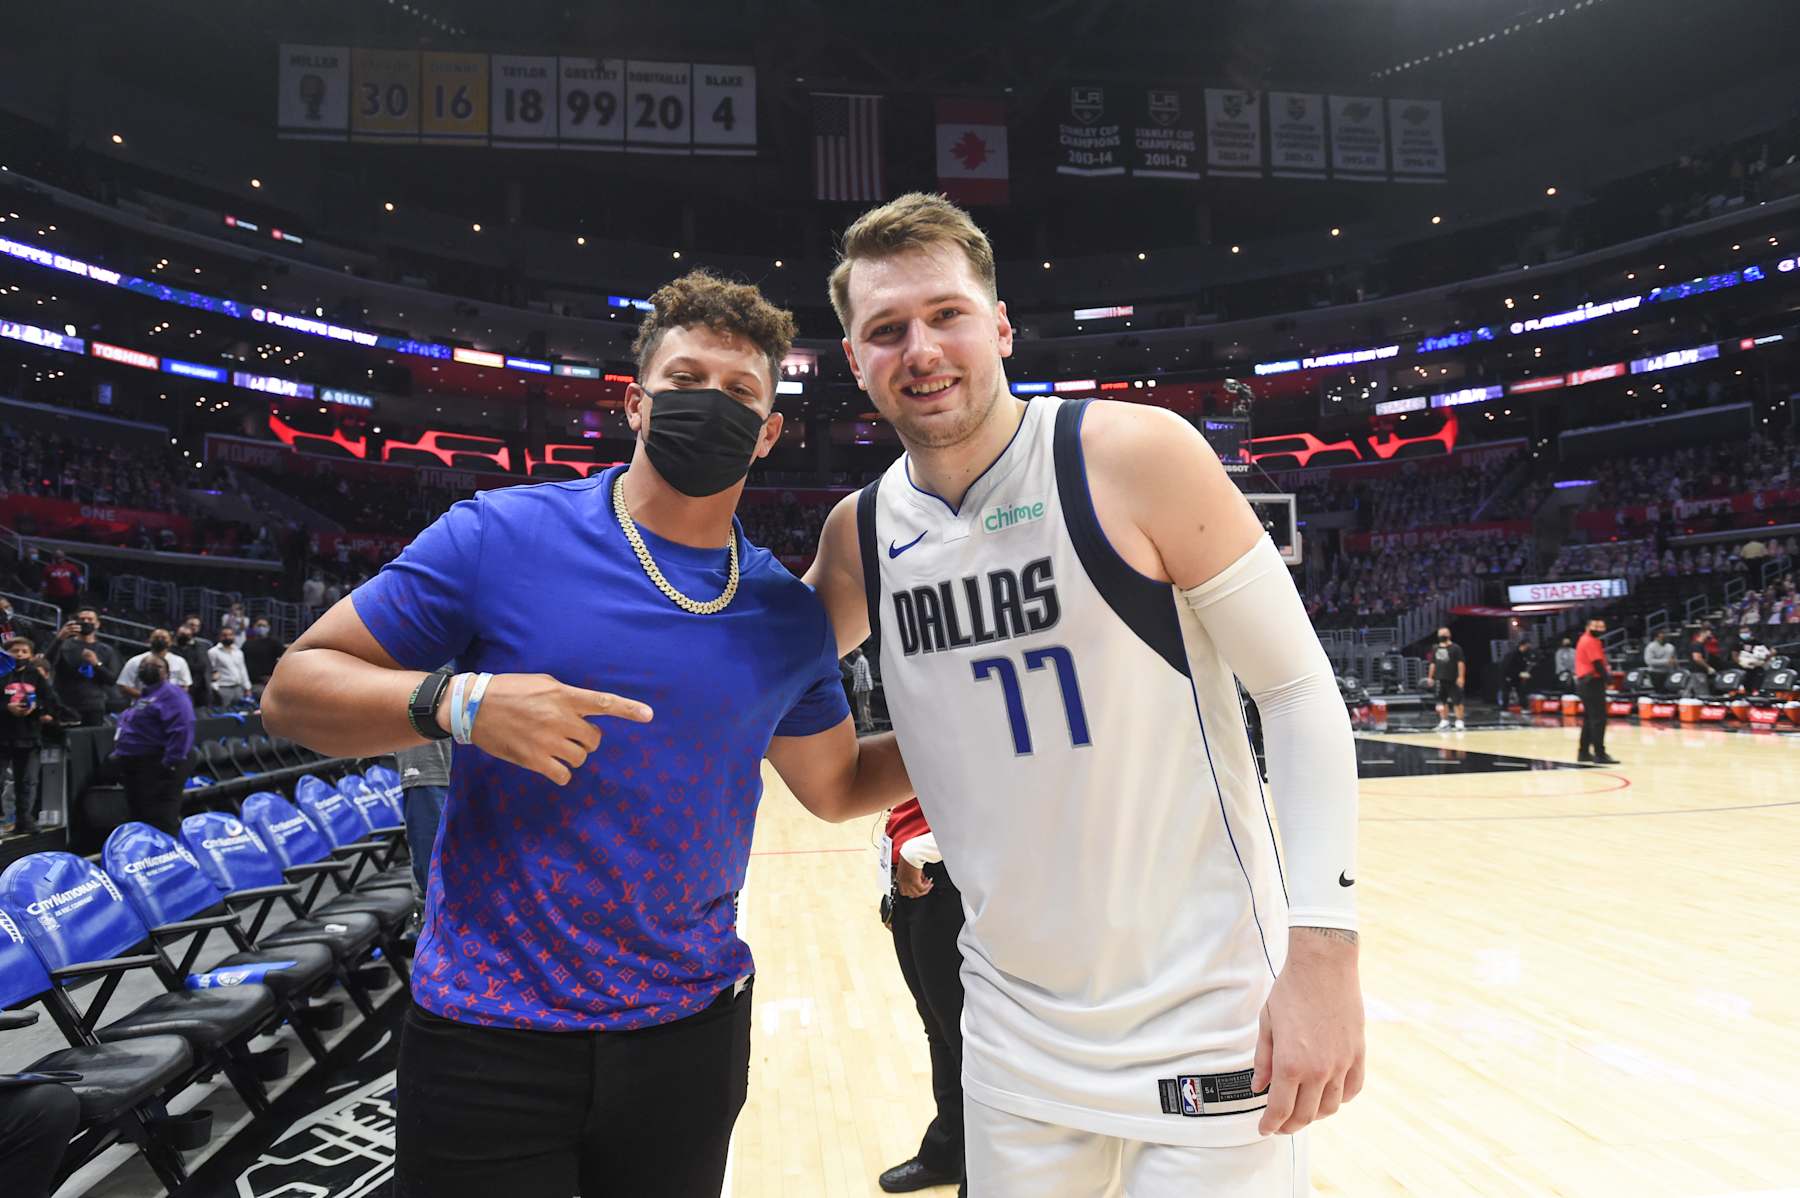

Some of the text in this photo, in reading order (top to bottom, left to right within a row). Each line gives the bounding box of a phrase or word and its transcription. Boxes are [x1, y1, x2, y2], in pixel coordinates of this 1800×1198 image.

[502, 66, 546, 79] TAYLOR
[705, 75, 743, 87] BLAKE
[361, 83, 408, 117] 30
[435, 84, 472, 119] 16
[505, 88, 545, 123] 18
[566, 90, 617, 126] 99
[633, 93, 684, 130] 20
[712, 96, 735, 131] 4
[1145, 153, 1188, 167] 2011-12
[94, 342, 159, 369] TOSHIBA
[335, 391, 372, 408] DELTA
[984, 501, 1045, 531] chime
[892, 556, 1062, 657] DALLAS
[1530, 583, 1601, 600] STAPLES
[969, 643, 1094, 758] 77
